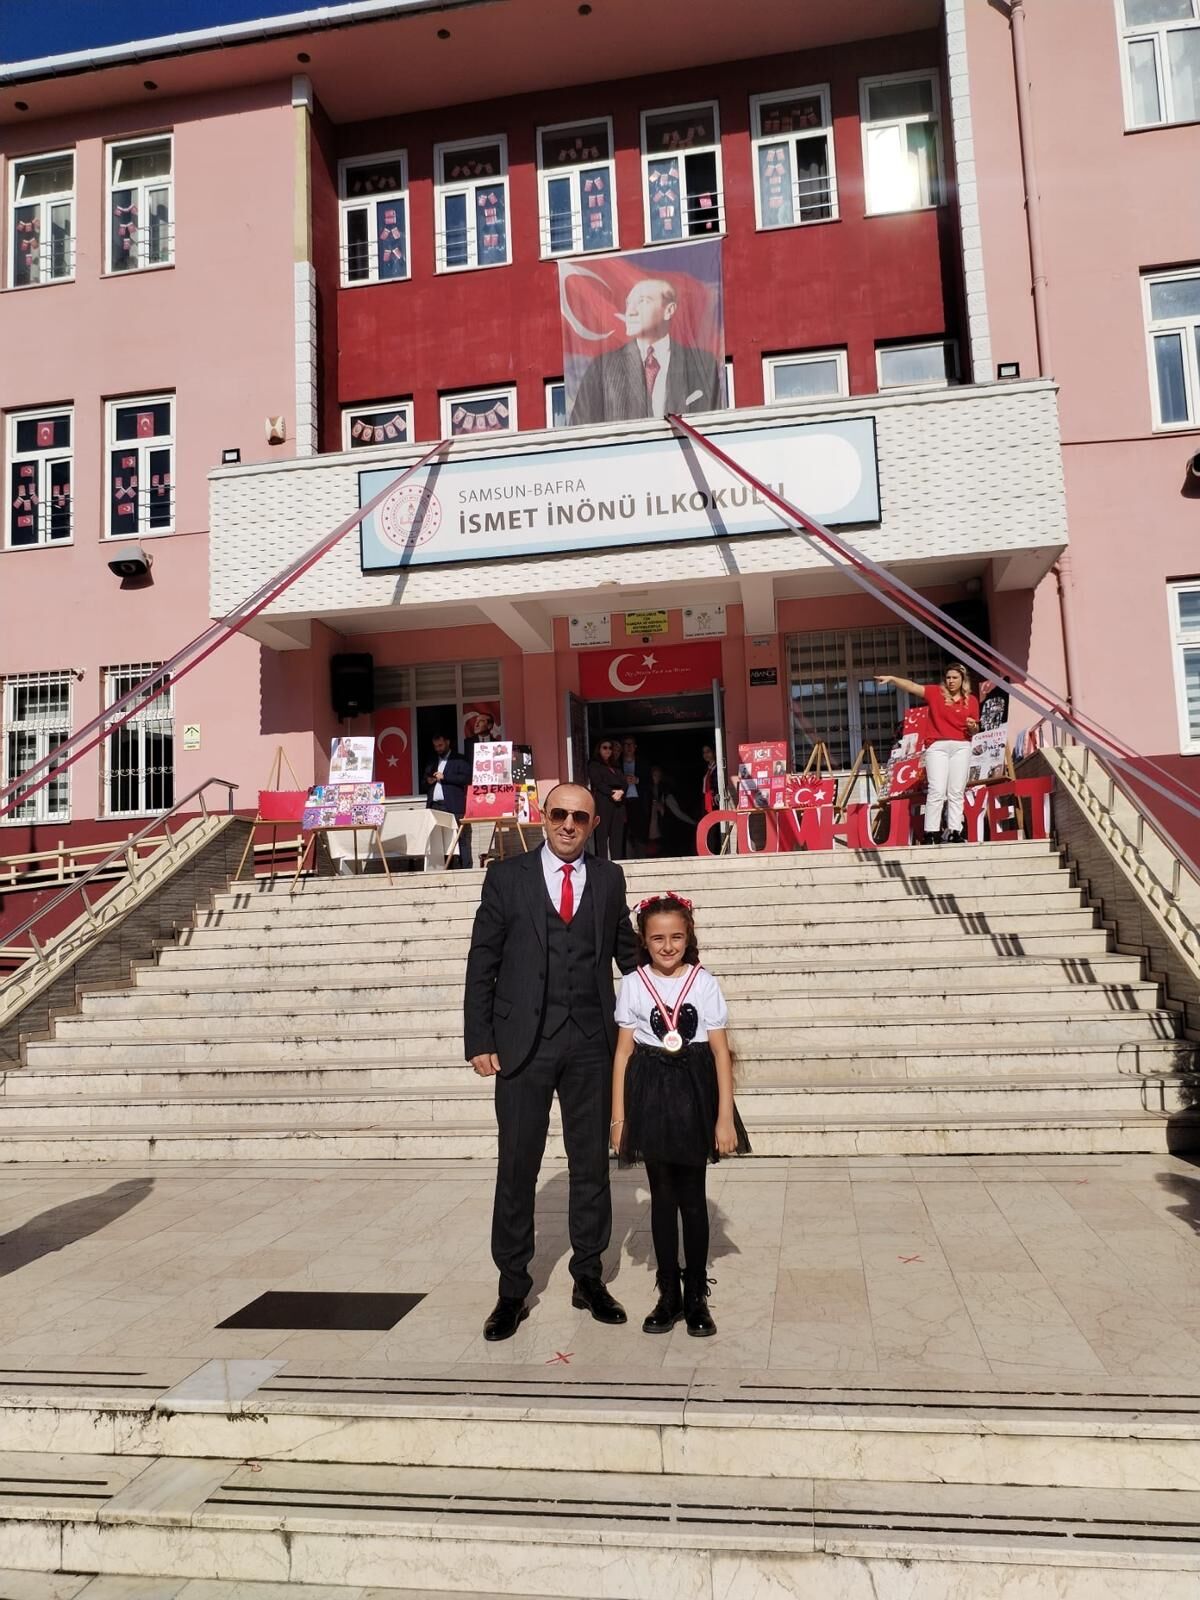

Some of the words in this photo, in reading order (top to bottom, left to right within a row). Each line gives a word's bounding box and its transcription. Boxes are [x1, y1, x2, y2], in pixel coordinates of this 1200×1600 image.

[458, 478, 586, 504] SAMSUN-BAFRA
[459, 502, 539, 534] İSMET
[547, 493, 636, 527] İNÖNÜ
[646, 482, 785, 517] İLKOKULU
[472, 784, 489, 796] 29
[695, 775, 1054, 857] CUMHUYET
